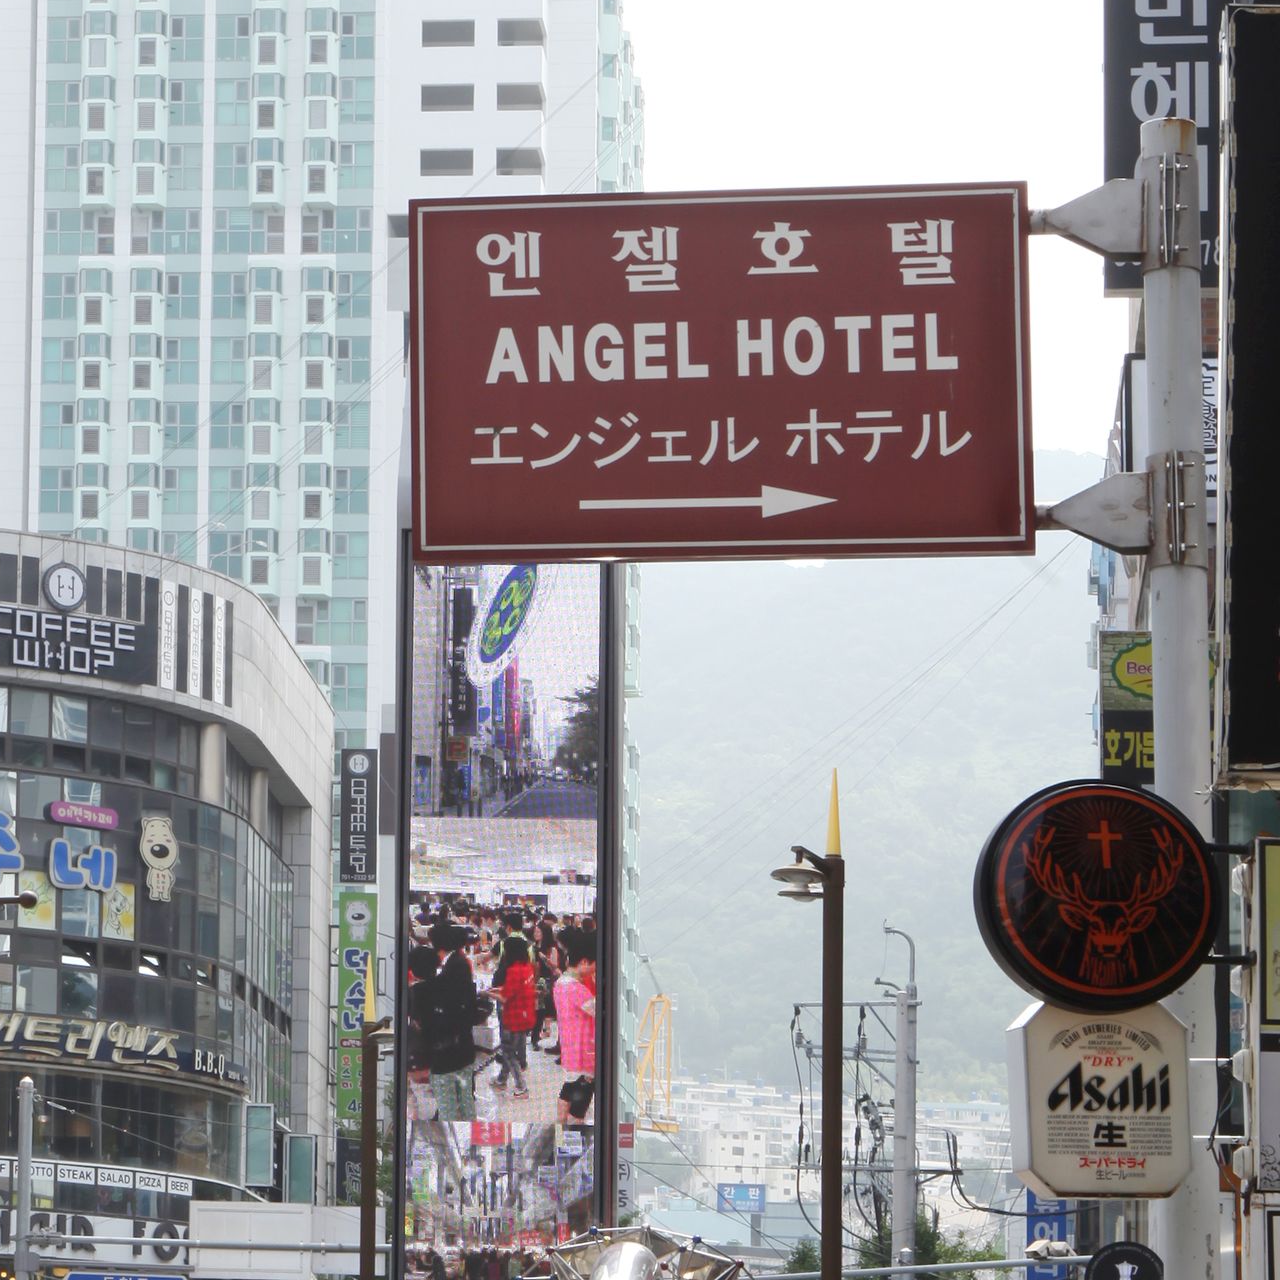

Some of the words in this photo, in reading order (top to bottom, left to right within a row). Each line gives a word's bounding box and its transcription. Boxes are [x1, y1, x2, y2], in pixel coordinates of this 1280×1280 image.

[485, 322, 709, 384] ANGEL
[736, 313, 958, 377] HOTEL
[471, 413, 760, 469] エンジェル
[786, 408, 972, 465] ホテル
[13, 639, 114, 675] WHO?
[1082, 1023, 1122, 1036] BREWERIES
[1125, 1029, 1151, 1051] LIMITED
[194, 1049, 225, 1075] B.B.Q
[1048, 1062, 1170, 1113] Asahi
[1094, 1121, 1128, 1148] 生
[59, 1168, 93, 1182] STEAK
[1079, 1157, 1147, 1168] スーパードライ
[99, 1172, 131, 1185] SALAD
[138, 1176, 162, 1189] PIZZA
[170, 1180, 190, 1193] BEER
[132, 1221, 190, 1266] FO
